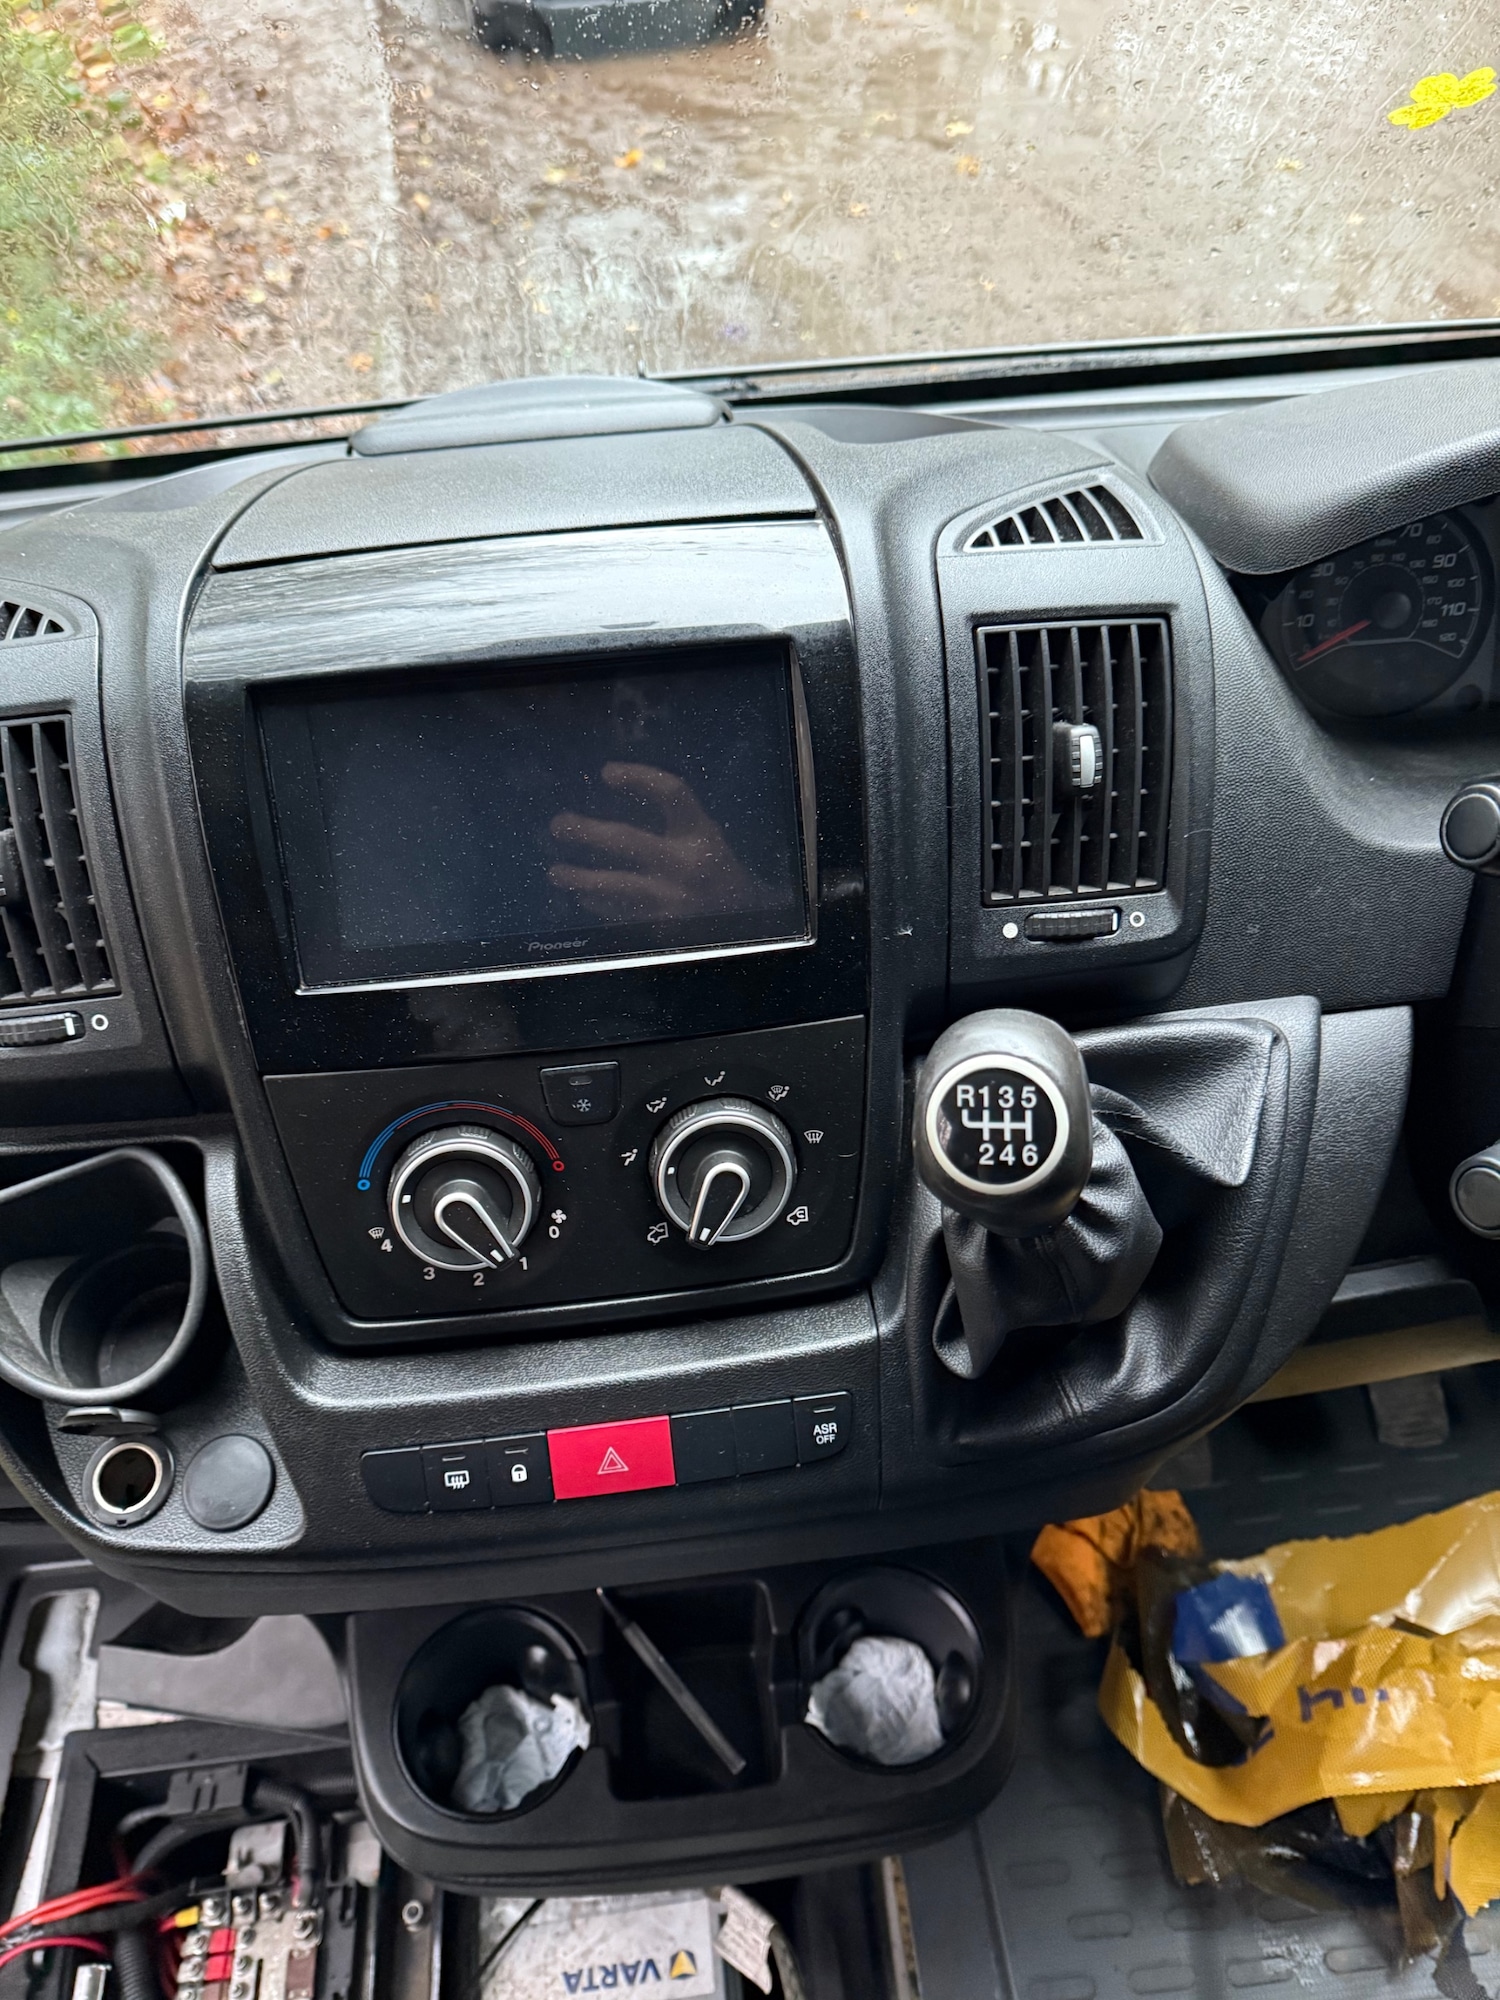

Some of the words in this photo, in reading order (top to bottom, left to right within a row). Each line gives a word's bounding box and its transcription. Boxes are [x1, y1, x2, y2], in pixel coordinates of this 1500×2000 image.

[1431, 552, 1458, 569] 90
[1310, 561, 1335, 578] 30
[1440, 601, 1467, 617] 110
[1295, 613, 1315, 628] 10
[524, 939, 588, 952] Pioneer
[957, 1084, 975, 1107] R
[978, 1085, 990, 1108] 1
[998, 1085, 1015, 1109] 3
[1021, 1086, 1037, 1109] 5
[979, 1143, 995, 1166] 2
[999, 1144, 1016, 1166] 4
[1021, 1144, 1039, 1167] 6
[548, 1225, 560, 1239] 0
[381, 1238, 393, 1253] 4
[519, 1256, 528, 1271] 1
[423, 1266, 436, 1281] 3
[472, 1272, 485, 1286] 2
[813, 1422, 837, 1436] ASR
[815, 1434, 836, 1445] OFF
[562, 1958, 662, 1995] VARTA
